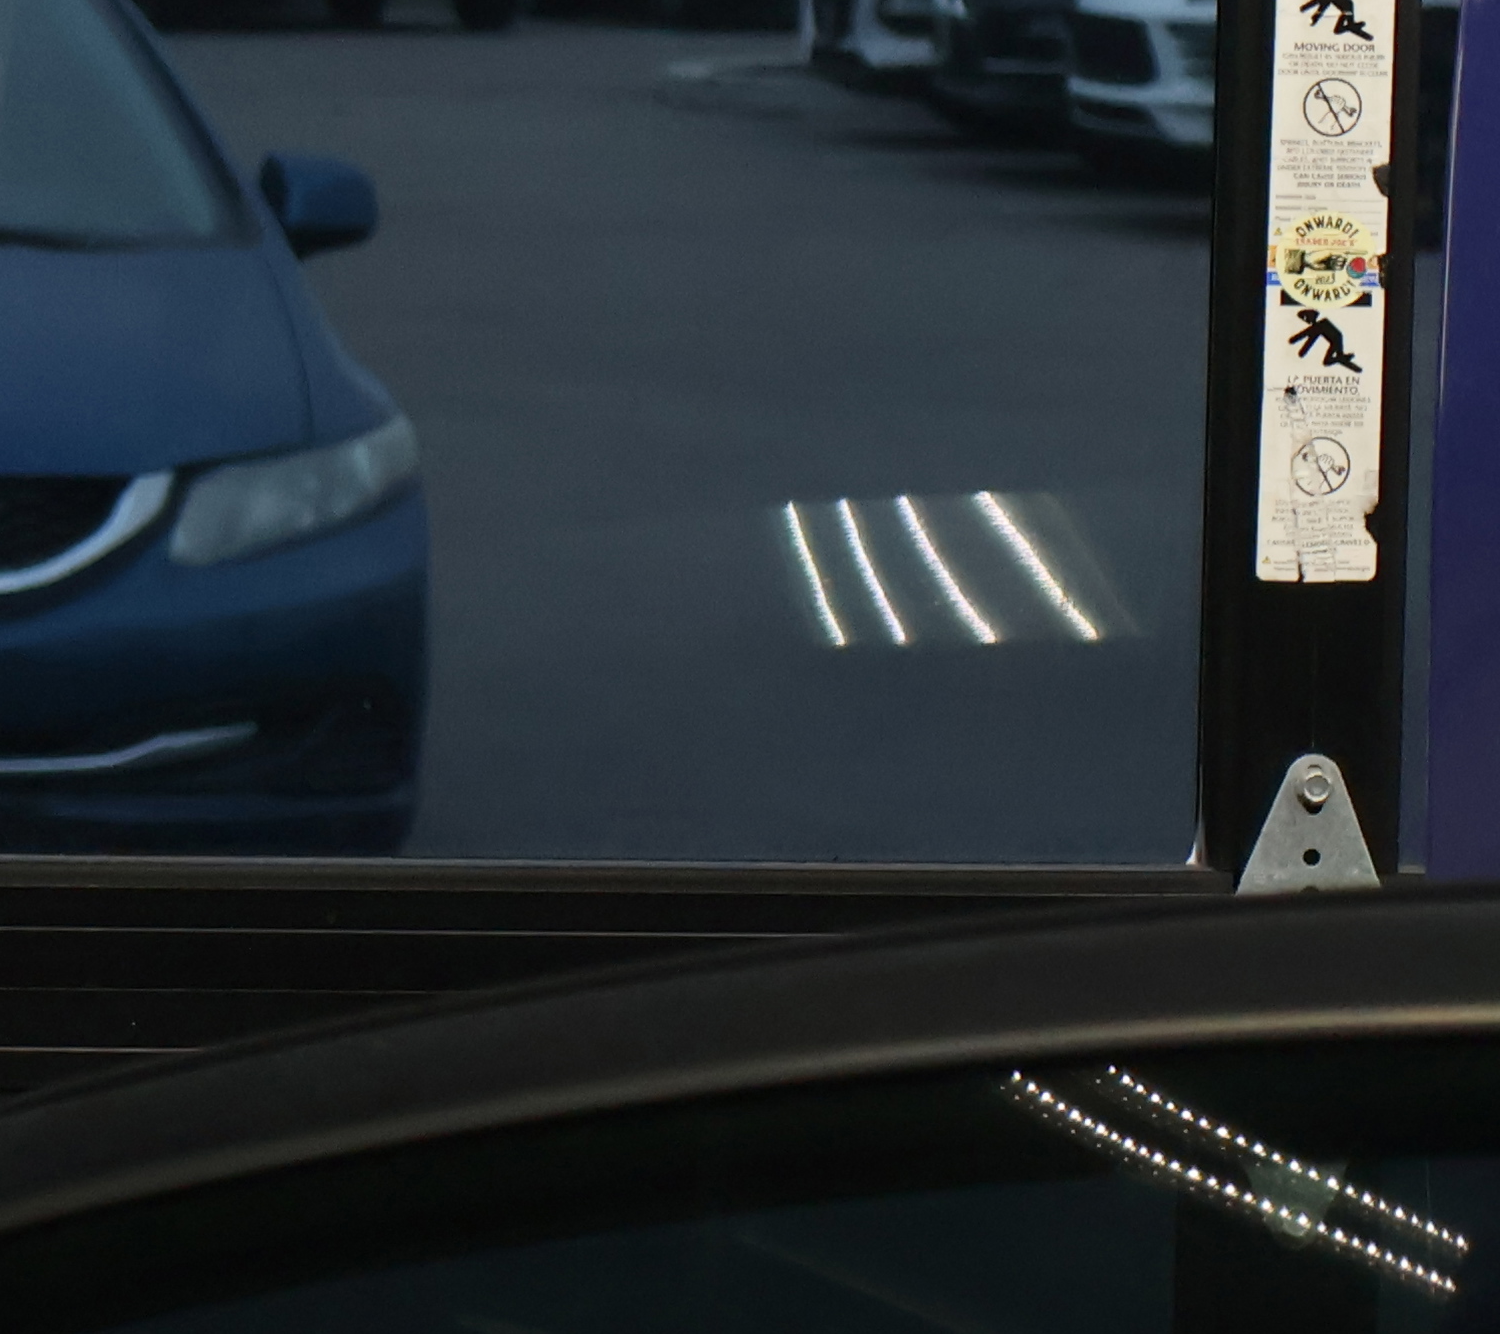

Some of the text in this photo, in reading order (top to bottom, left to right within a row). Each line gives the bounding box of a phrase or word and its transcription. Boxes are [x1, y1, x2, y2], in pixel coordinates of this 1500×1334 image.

[1293, 42, 1375, 53] MOVING DOOR
[1295, 215, 1361, 239] ONWARD!
[1294, 278, 1357, 303] ONWARD!
[1303, 375, 1343, 385] PUERTA
[1345, 376, 1360, 385] EN
